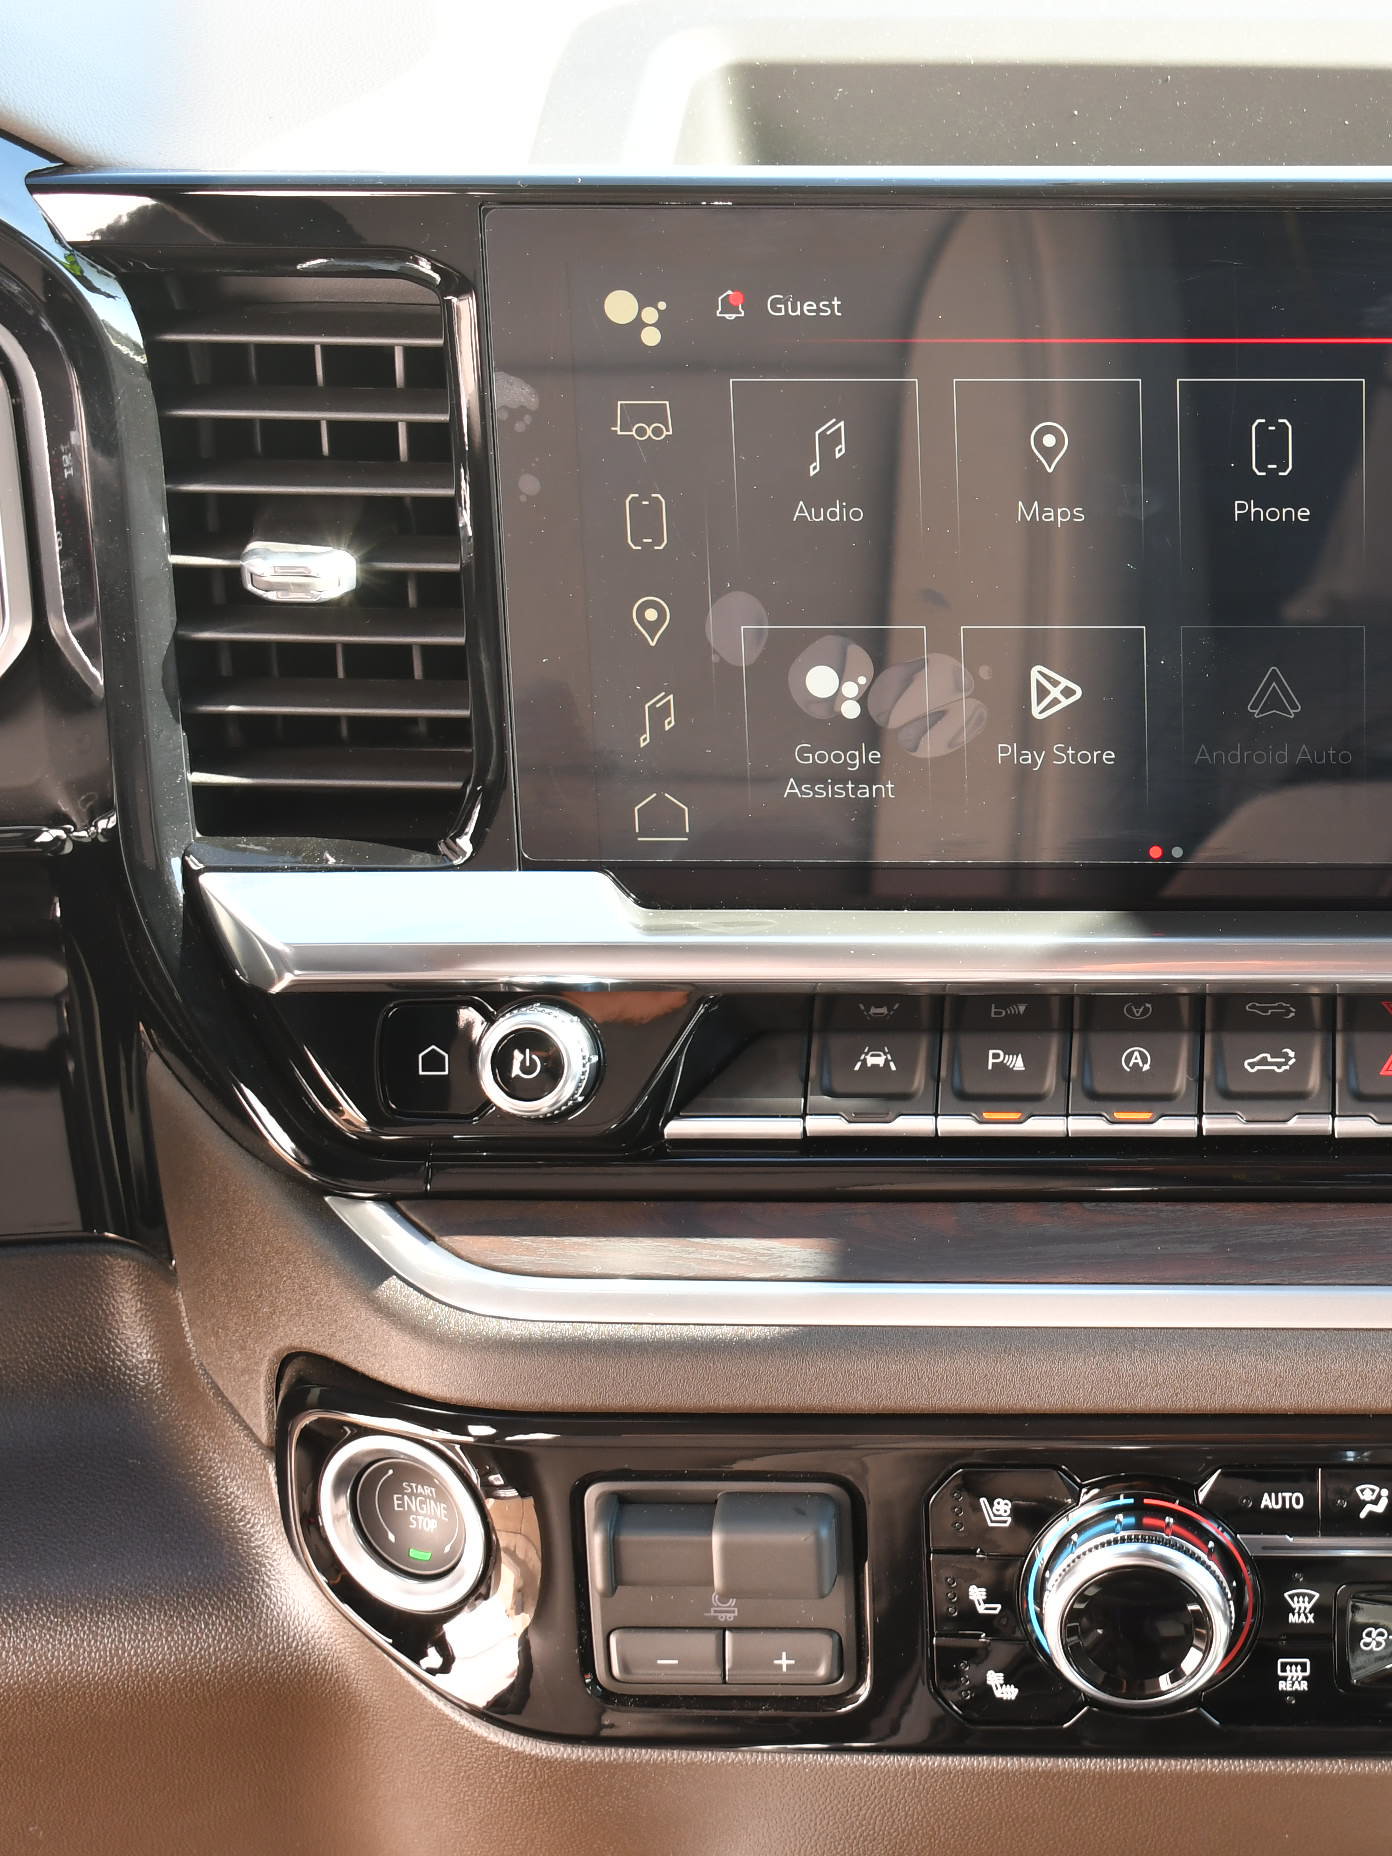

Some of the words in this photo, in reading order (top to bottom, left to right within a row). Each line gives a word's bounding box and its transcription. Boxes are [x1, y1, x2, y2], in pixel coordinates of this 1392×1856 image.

[767, 295, 843, 317] Guest
[793, 501, 864, 522] Audio
[1017, 501, 1085, 528] Maps
[1234, 501, 1310, 522] Phone
[794, 743, 881, 770] Google
[998, 743, 1046, 770] Play
[1053, 743, 1116, 764] Store
[1194, 744, 1288, 765] Android
[1296, 745, 1353, 765] Auto
[784, 778, 896, 799] Assistant
[402, 1482, 436, 1498] START
[393, 1494, 448, 1521] ENGINE
[1260, 1492, 1304, 1510] AUTO
[409, 1515, 438, 1533] STOP
[1288, 1612, 1315, 1624] MAX
[1278, 1679, 1308, 1691] REAR
